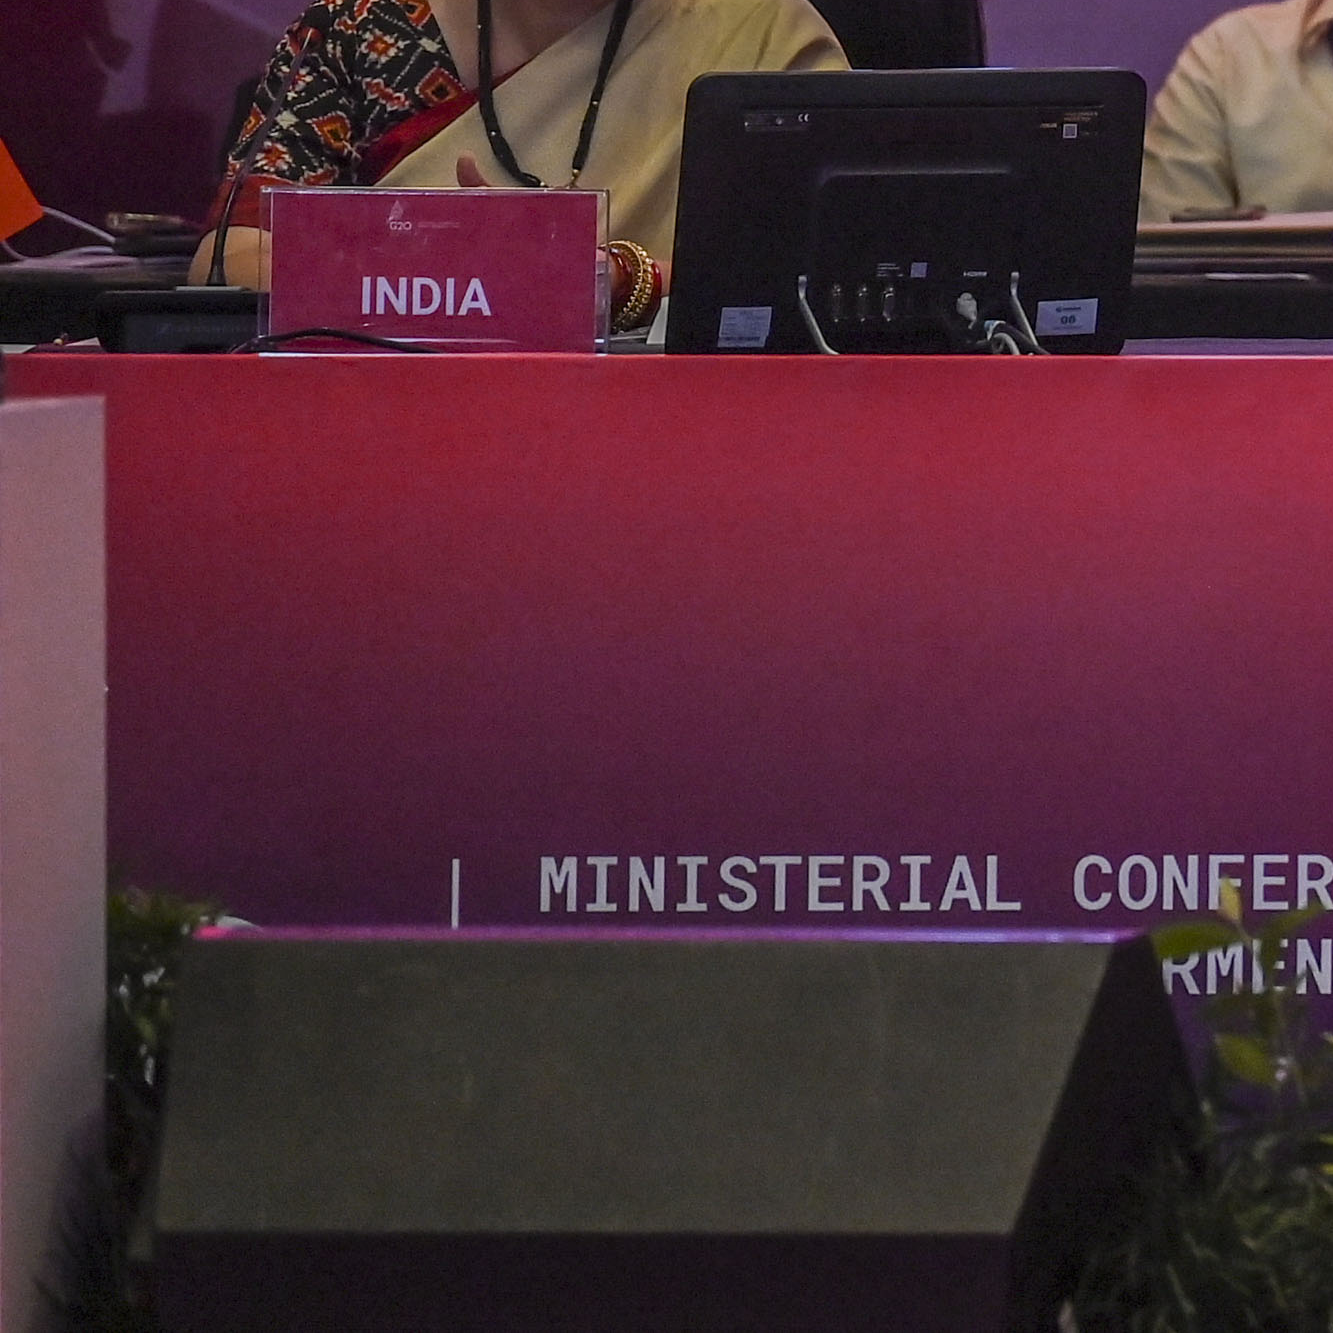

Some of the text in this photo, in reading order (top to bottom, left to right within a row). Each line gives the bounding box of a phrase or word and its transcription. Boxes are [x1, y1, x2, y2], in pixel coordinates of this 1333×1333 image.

[388, 221, 412, 230] G20
[361, 276, 492, 317] INDIA
[539, 854, 1022, 913] MINISTERIAL
